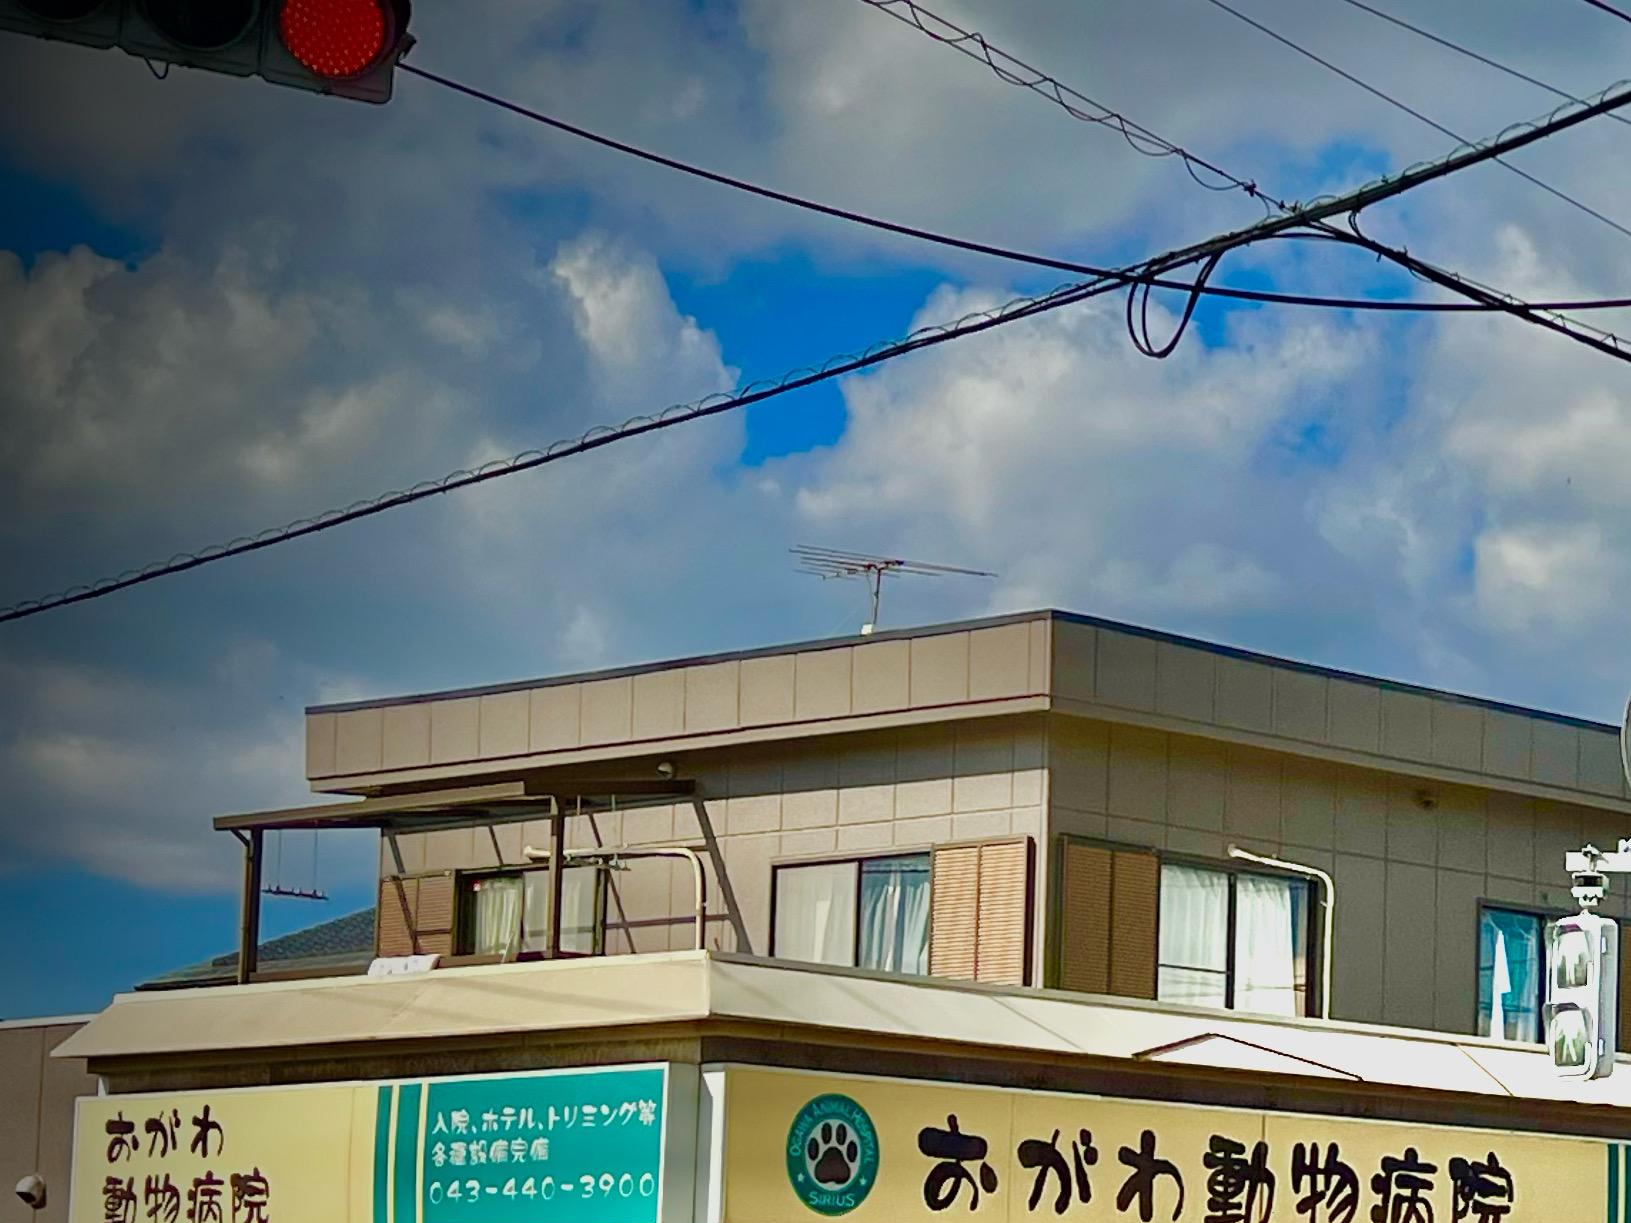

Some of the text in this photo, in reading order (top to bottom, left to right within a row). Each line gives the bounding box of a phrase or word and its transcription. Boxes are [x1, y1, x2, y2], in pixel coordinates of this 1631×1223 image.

[105, 1104, 224, 1164] おがわ
[429, 1172, 656, 1205] 043-440-3900
[808, 1190, 856, 1208] SIRIUS
